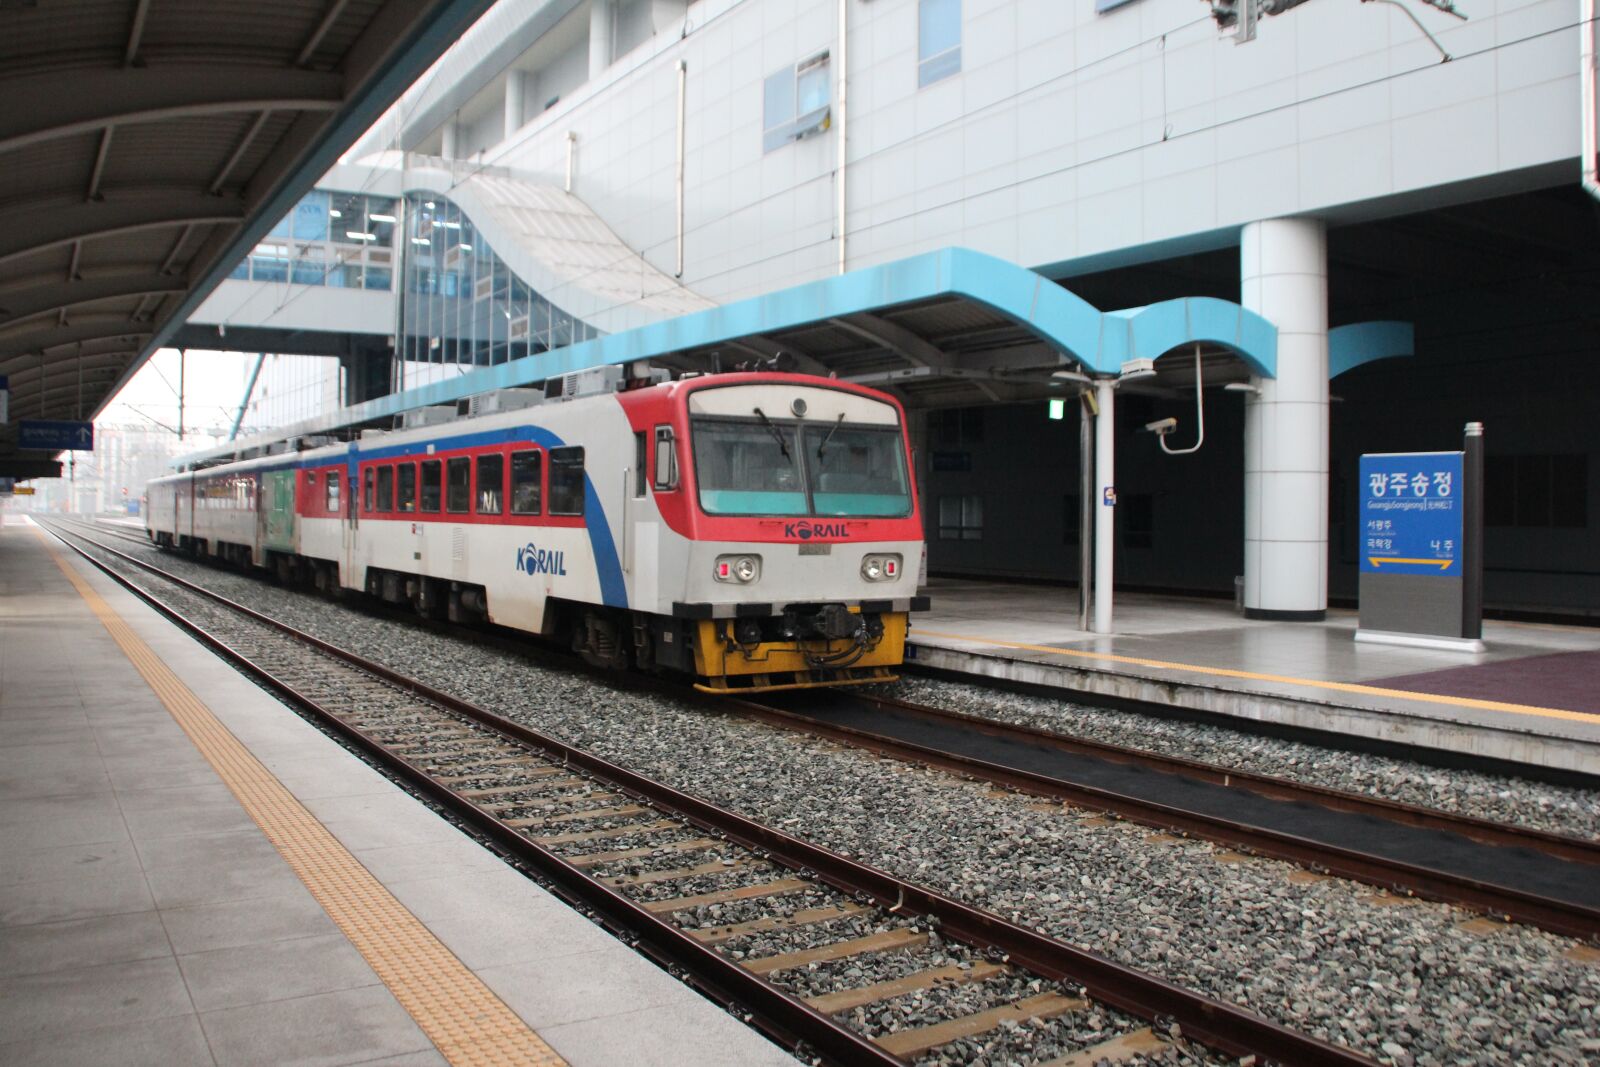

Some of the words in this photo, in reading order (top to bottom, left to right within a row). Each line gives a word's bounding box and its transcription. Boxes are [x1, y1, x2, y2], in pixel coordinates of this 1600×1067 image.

[1369, 471, 1452, 497] 광주송정
[784, 520, 849, 539] KORAIL
[1367, 519, 1392, 531] 서광주
[516, 542, 567, 576] KORAIL
